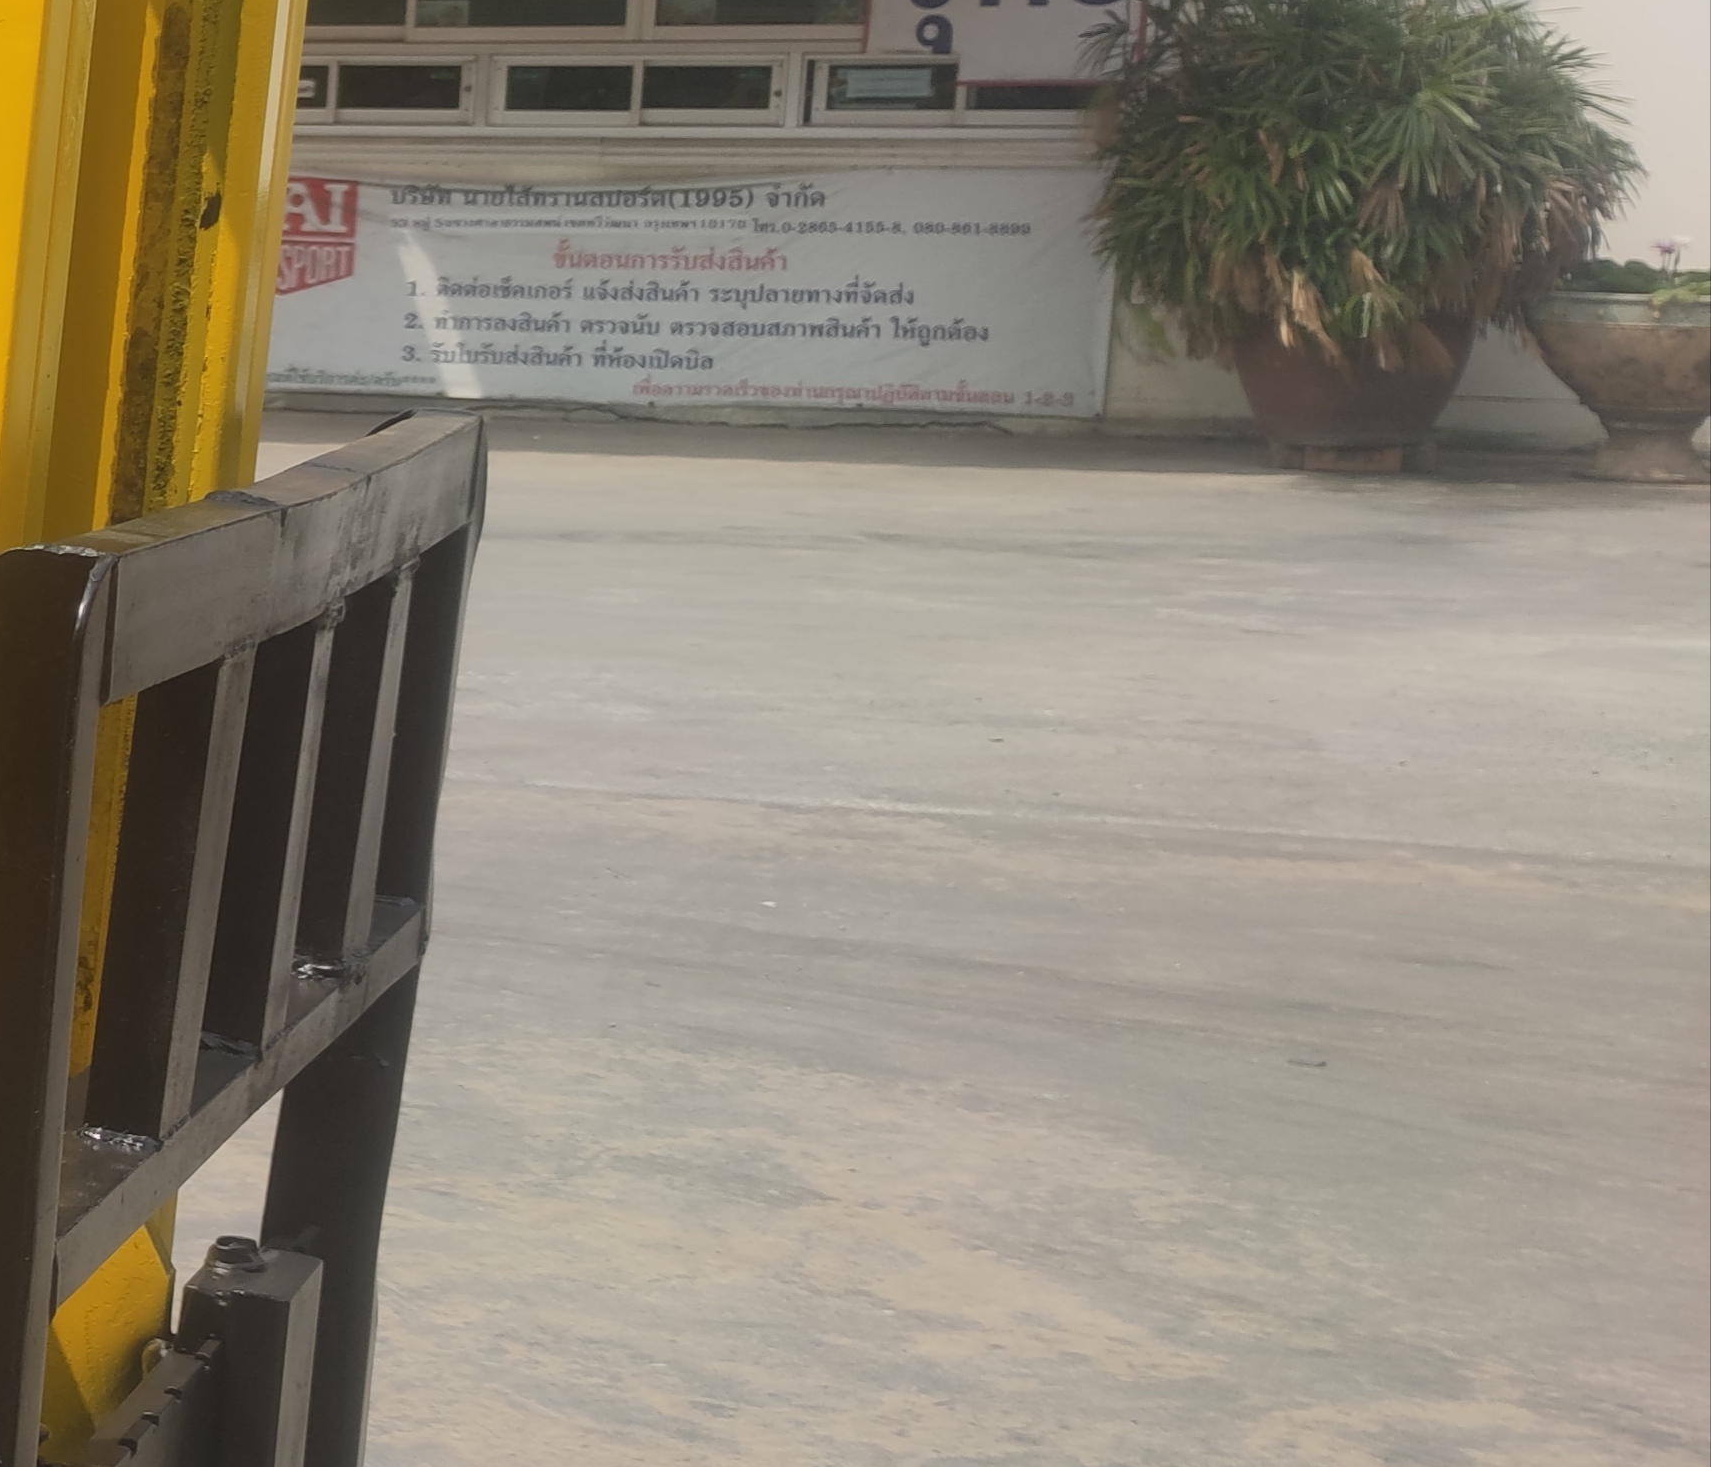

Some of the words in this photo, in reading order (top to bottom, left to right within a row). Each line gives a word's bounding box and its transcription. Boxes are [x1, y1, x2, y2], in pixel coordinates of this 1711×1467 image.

[391, 184, 452, 206] บริษัท
[765, 183, 827, 209] จำกัด
[552, 237, 788, 270] ขั้นตอนการรับส่งสินค้า
[407, 282, 425, 298] 1.
[582, 279, 699, 303] แจ้งส่งสินค้า
[711, 276, 915, 310] ระบุปลายทางที่จัดส่ง
[404, 312, 424, 329] 2.
[579, 313, 661, 336] ตรวจนับ
[891, 316, 990, 347] ให้ถูกต้อง
[402, 345, 422, 363] 3.
